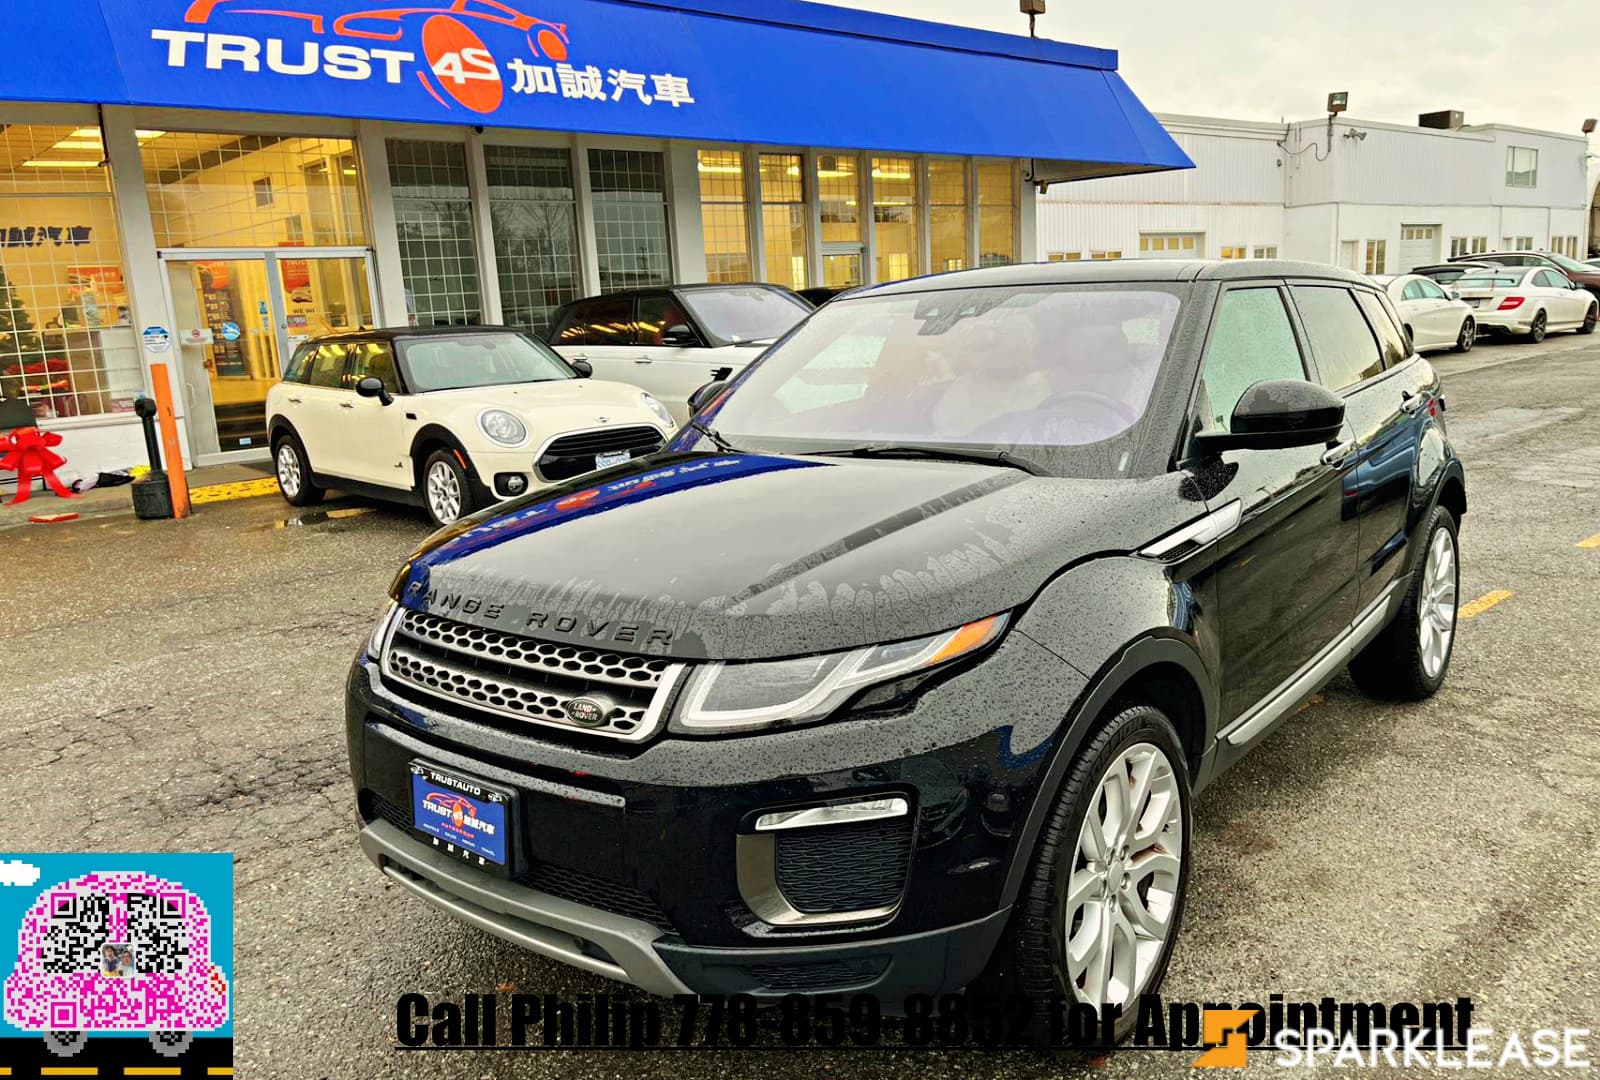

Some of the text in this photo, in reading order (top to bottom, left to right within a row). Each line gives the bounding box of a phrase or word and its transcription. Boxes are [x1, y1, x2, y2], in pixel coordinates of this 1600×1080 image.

[151, 28, 500, 85] TRUST 4S
[507, 57, 695, 107] 加誠汽車
[407, 580, 674, 646] RANGE ROVER
[422, 799, 453, 818] TRUST
[430, 772, 481, 796] TRUSTAUTO
